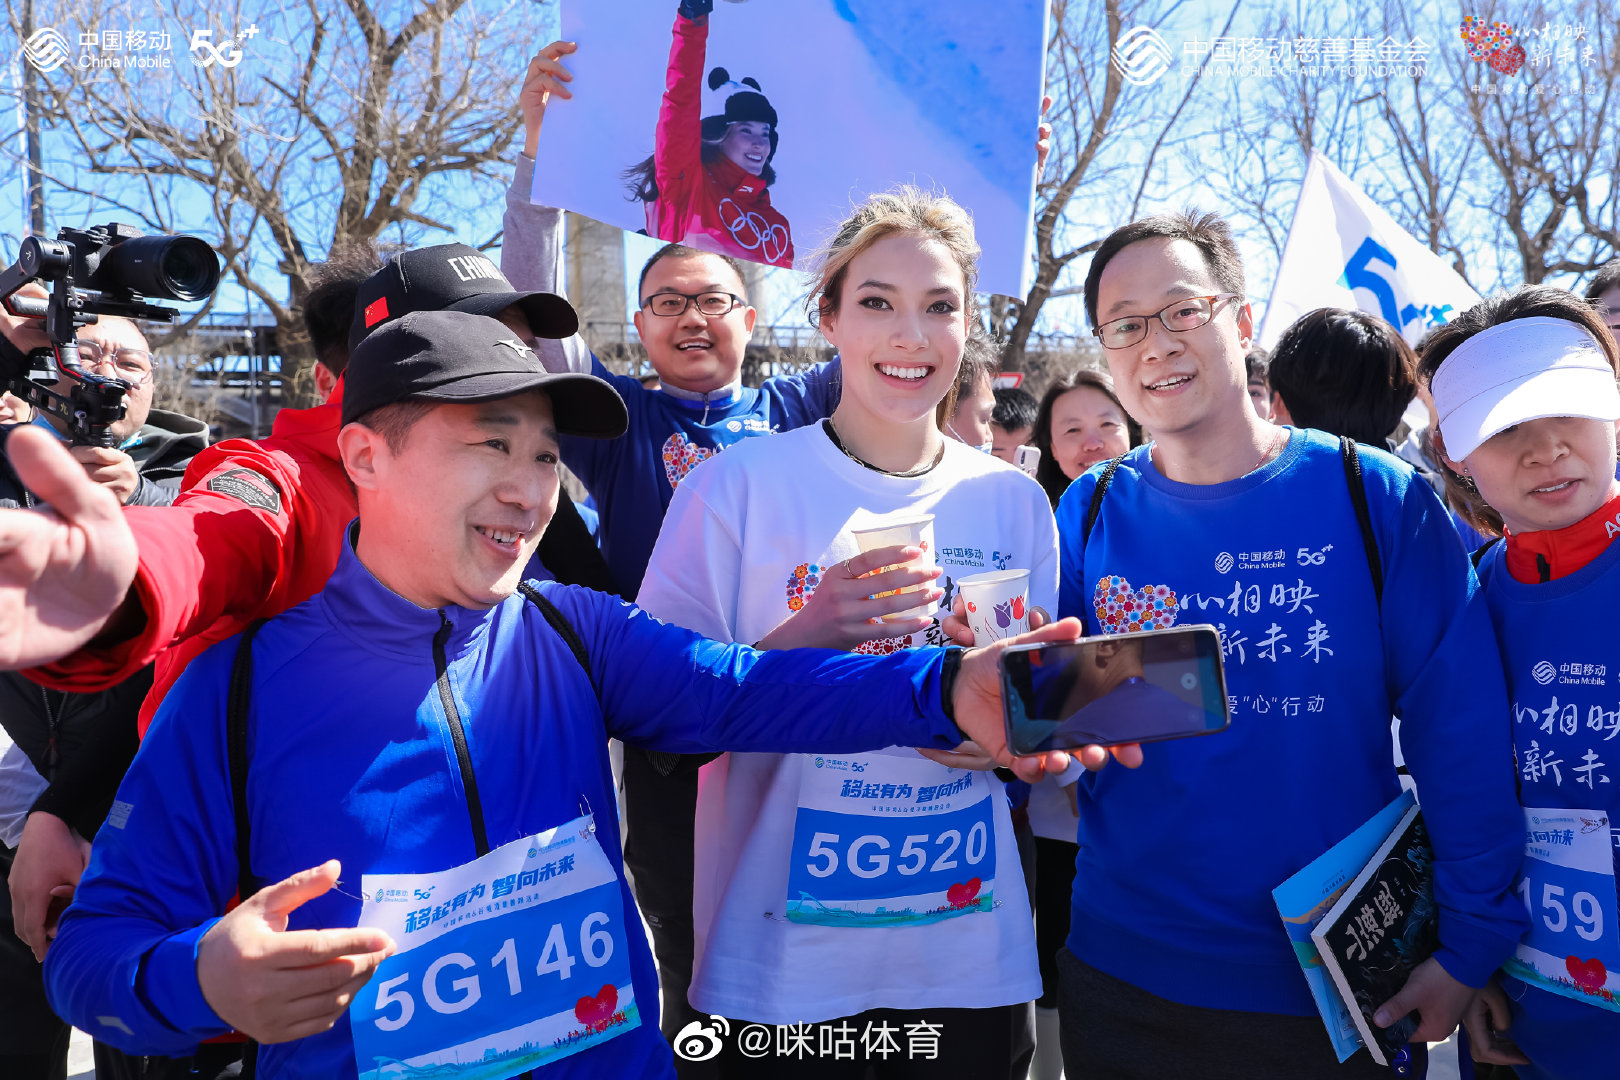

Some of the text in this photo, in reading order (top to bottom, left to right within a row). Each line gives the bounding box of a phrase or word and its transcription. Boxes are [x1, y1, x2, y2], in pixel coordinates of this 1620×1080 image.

[447, 255, 506, 283] CHINA
[942, 547, 984, 560] 中国移动
[1238, 561, 1286, 570] China Mobile
[1239, 549, 1286, 562] 中国移动
[1180, 578, 1320, 617] 心相映
[1218, 619, 1334, 665] 新未来
[1558, 676, 1606, 686] China Mobile
[1559, 662, 1607, 677] 中国移动
[840, 771, 973, 803] 移起有为 智向未来
[806, 821, 987, 879] 5G520
[404, 853, 575, 934] 移起有为 智向未来
[1518, 877, 1604, 941] 159
[374, 911, 614, 1031] 5G146
